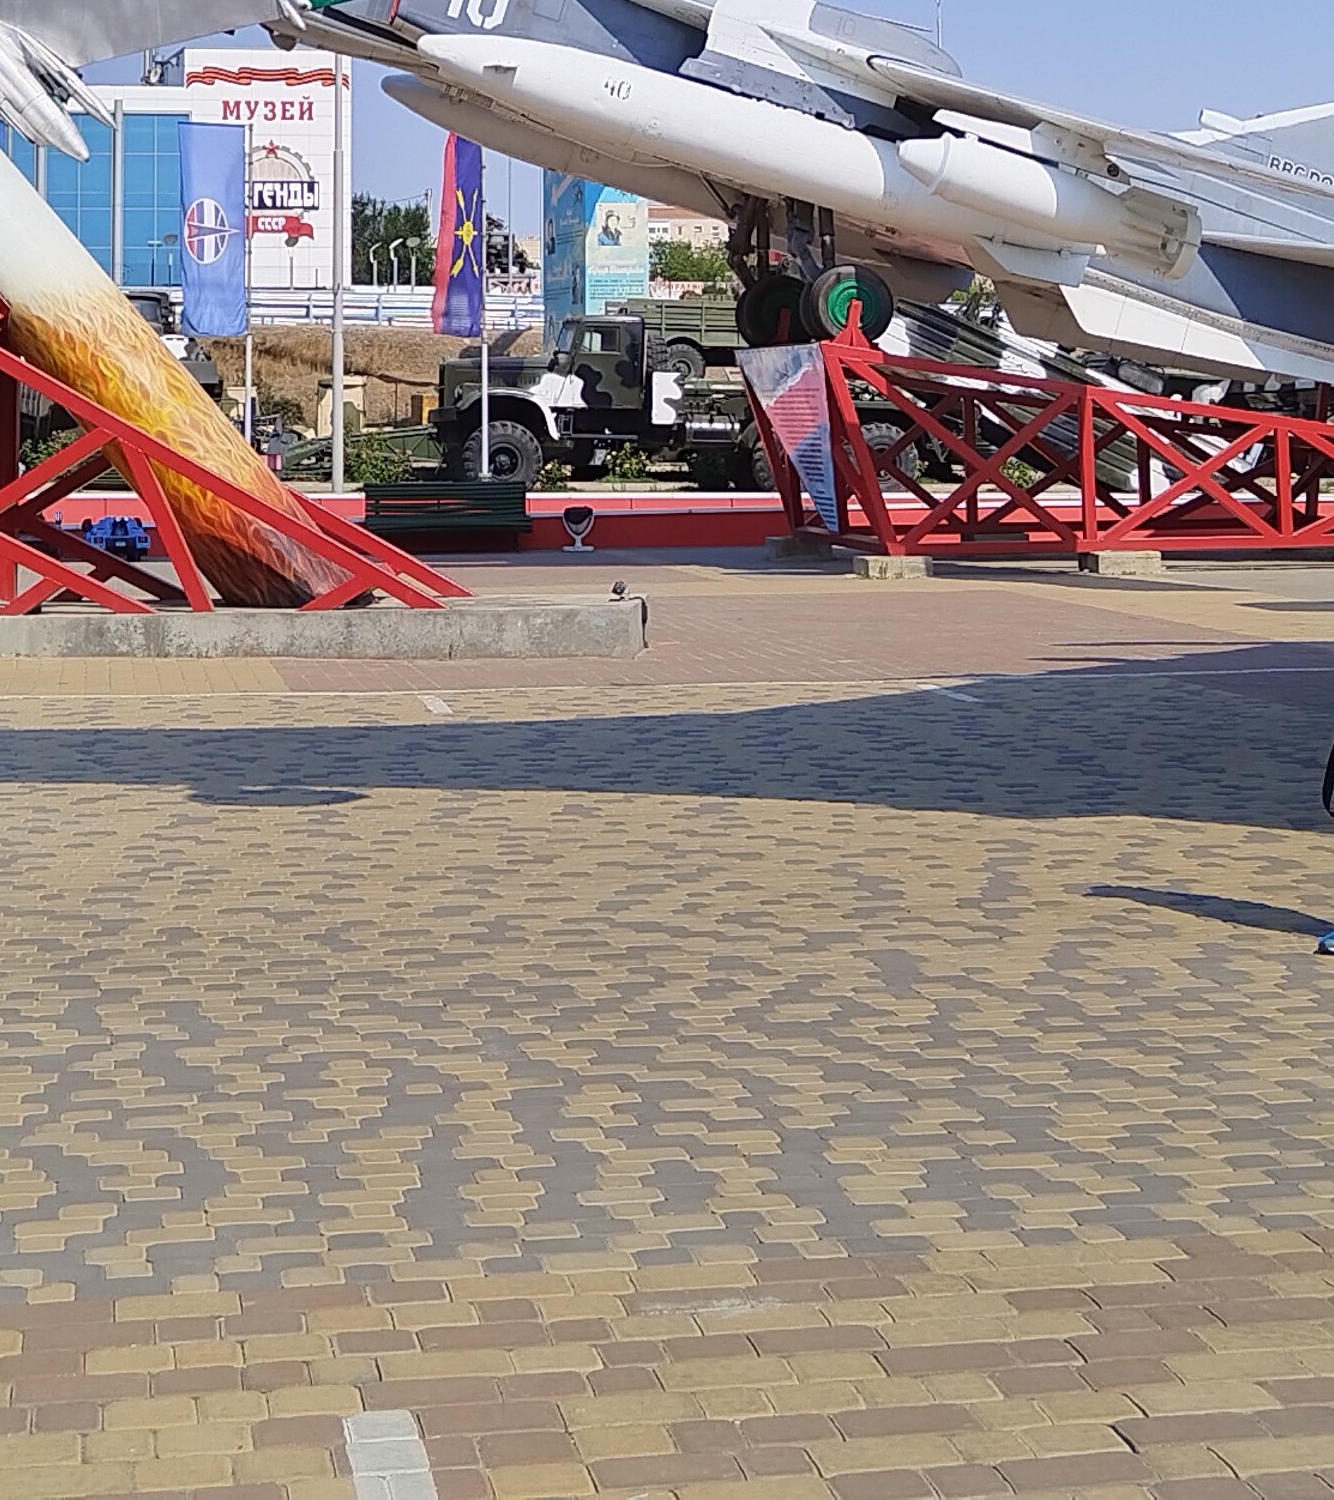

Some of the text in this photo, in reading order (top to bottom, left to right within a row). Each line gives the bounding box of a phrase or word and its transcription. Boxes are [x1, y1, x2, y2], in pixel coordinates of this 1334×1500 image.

[222, 95, 315, 121] МУЗЕЙ
[245, 182, 319, 208] ГЕНДЫ
[257, 216, 287, 232] СССР
